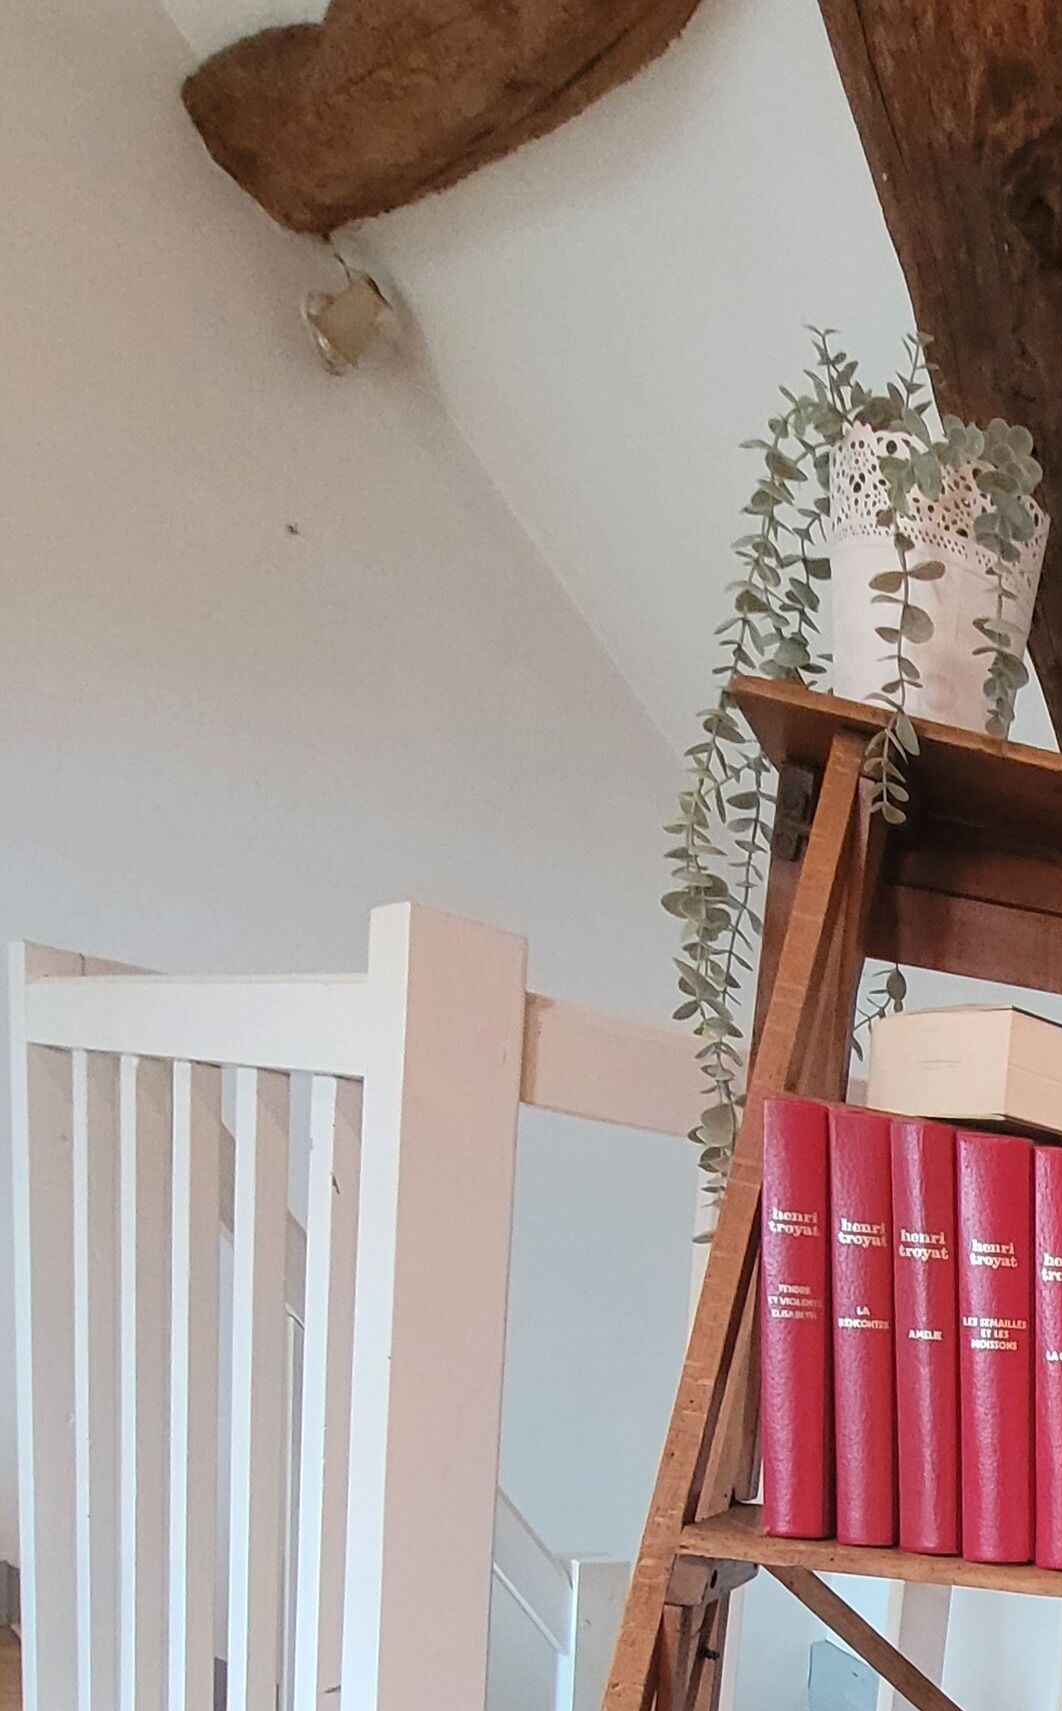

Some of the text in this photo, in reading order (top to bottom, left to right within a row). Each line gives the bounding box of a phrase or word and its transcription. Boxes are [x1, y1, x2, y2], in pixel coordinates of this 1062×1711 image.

[772, 1207, 818, 1223] henri
[768, 1220, 820, 1237] troyat
[841, 1218, 885, 1234] henri
[838, 1231, 888, 1248] troyat
[900, 1229, 946, 1245] henri
[899, 1244, 949, 1261] troyat
[971, 1239, 1014, 1255] henri
[969, 1252, 1018, 1269] troyat
[856, 1306, 870, 1316] LA
[979, 1317, 1027, 1330] SEMAILLES
[981, 1329, 1009, 1339] ET LES
[971, 1339, 1017, 1351] MOISSONS
[1046, 1350, 1059, 1361] LA
